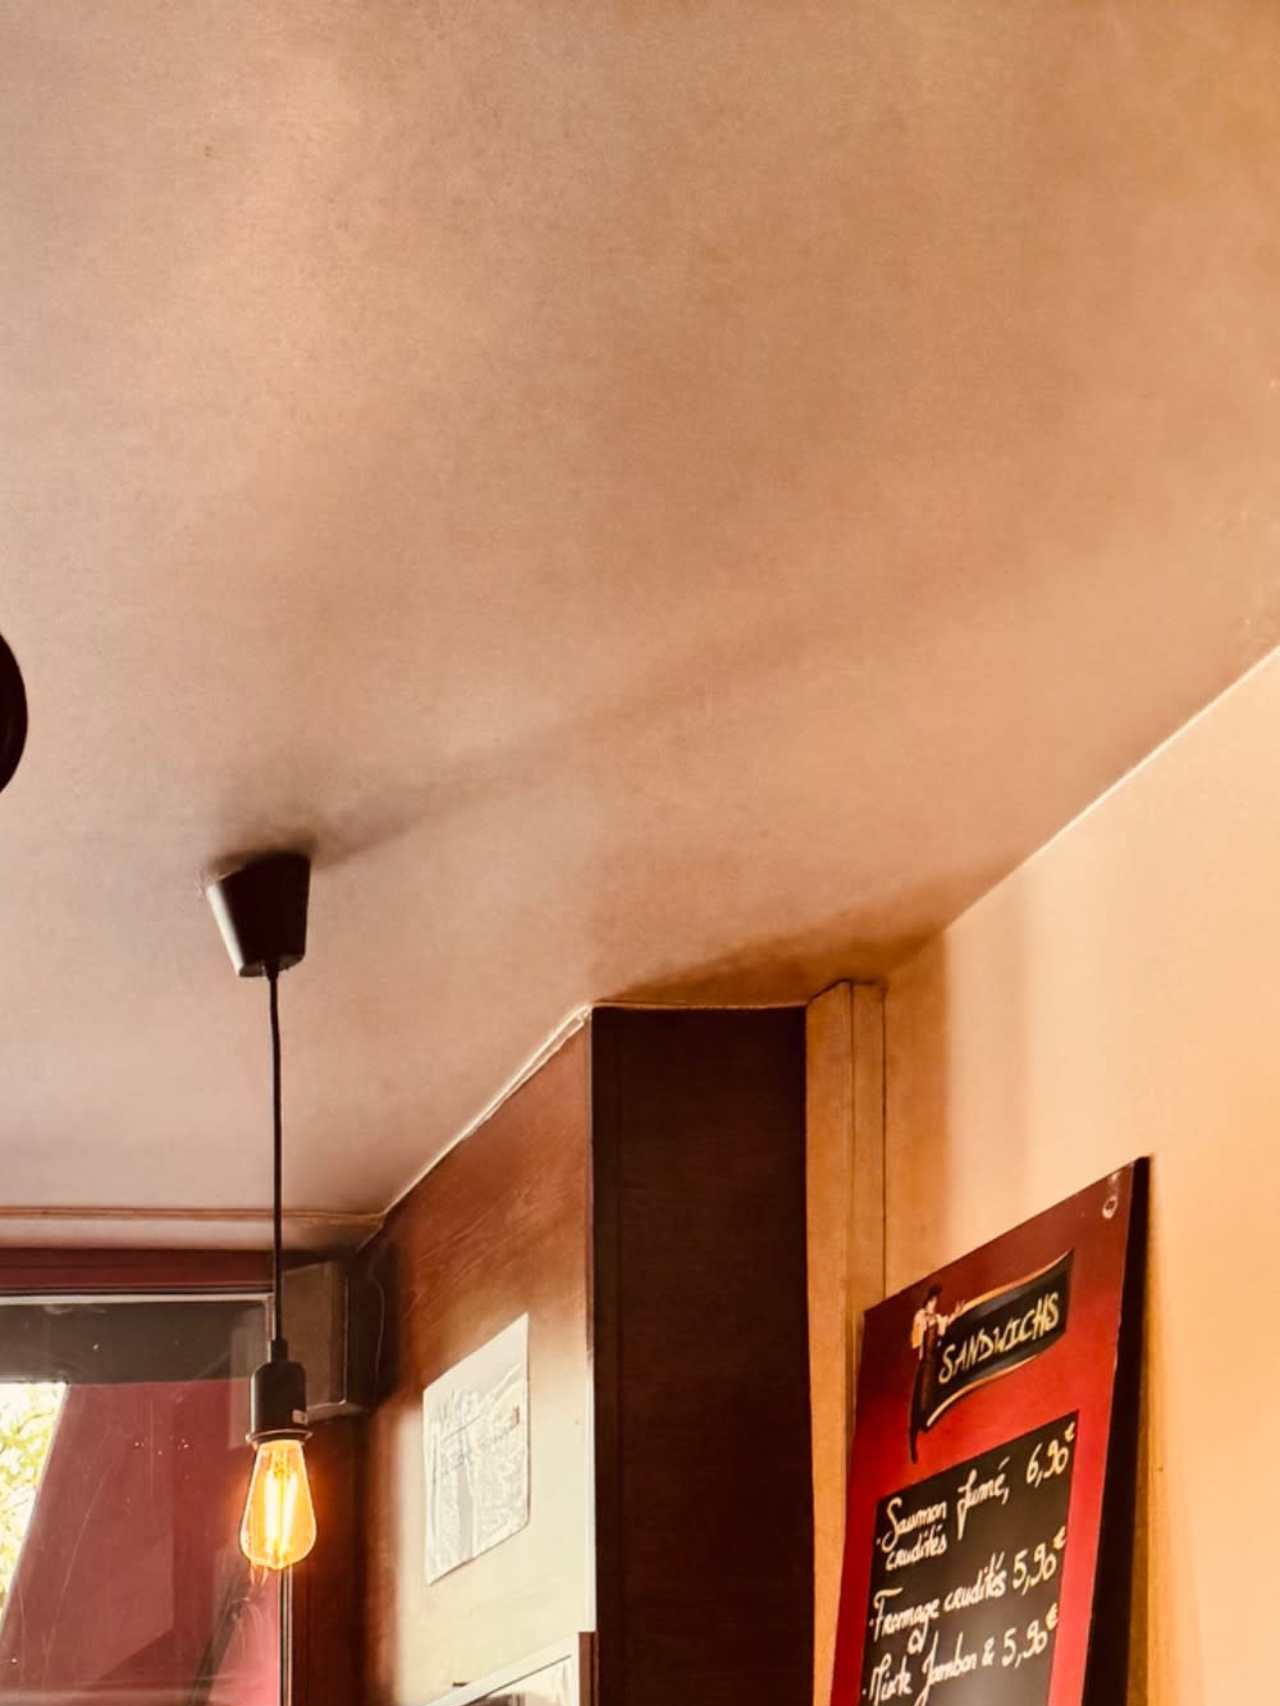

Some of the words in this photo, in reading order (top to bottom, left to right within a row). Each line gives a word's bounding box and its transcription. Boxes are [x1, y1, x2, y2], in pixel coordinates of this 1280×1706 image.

[939, 1292, 1059, 1384] SANDWICHS
[882, 1498, 947, 1552] Saumon
[874, 1588, 939, 1654] Fromage
